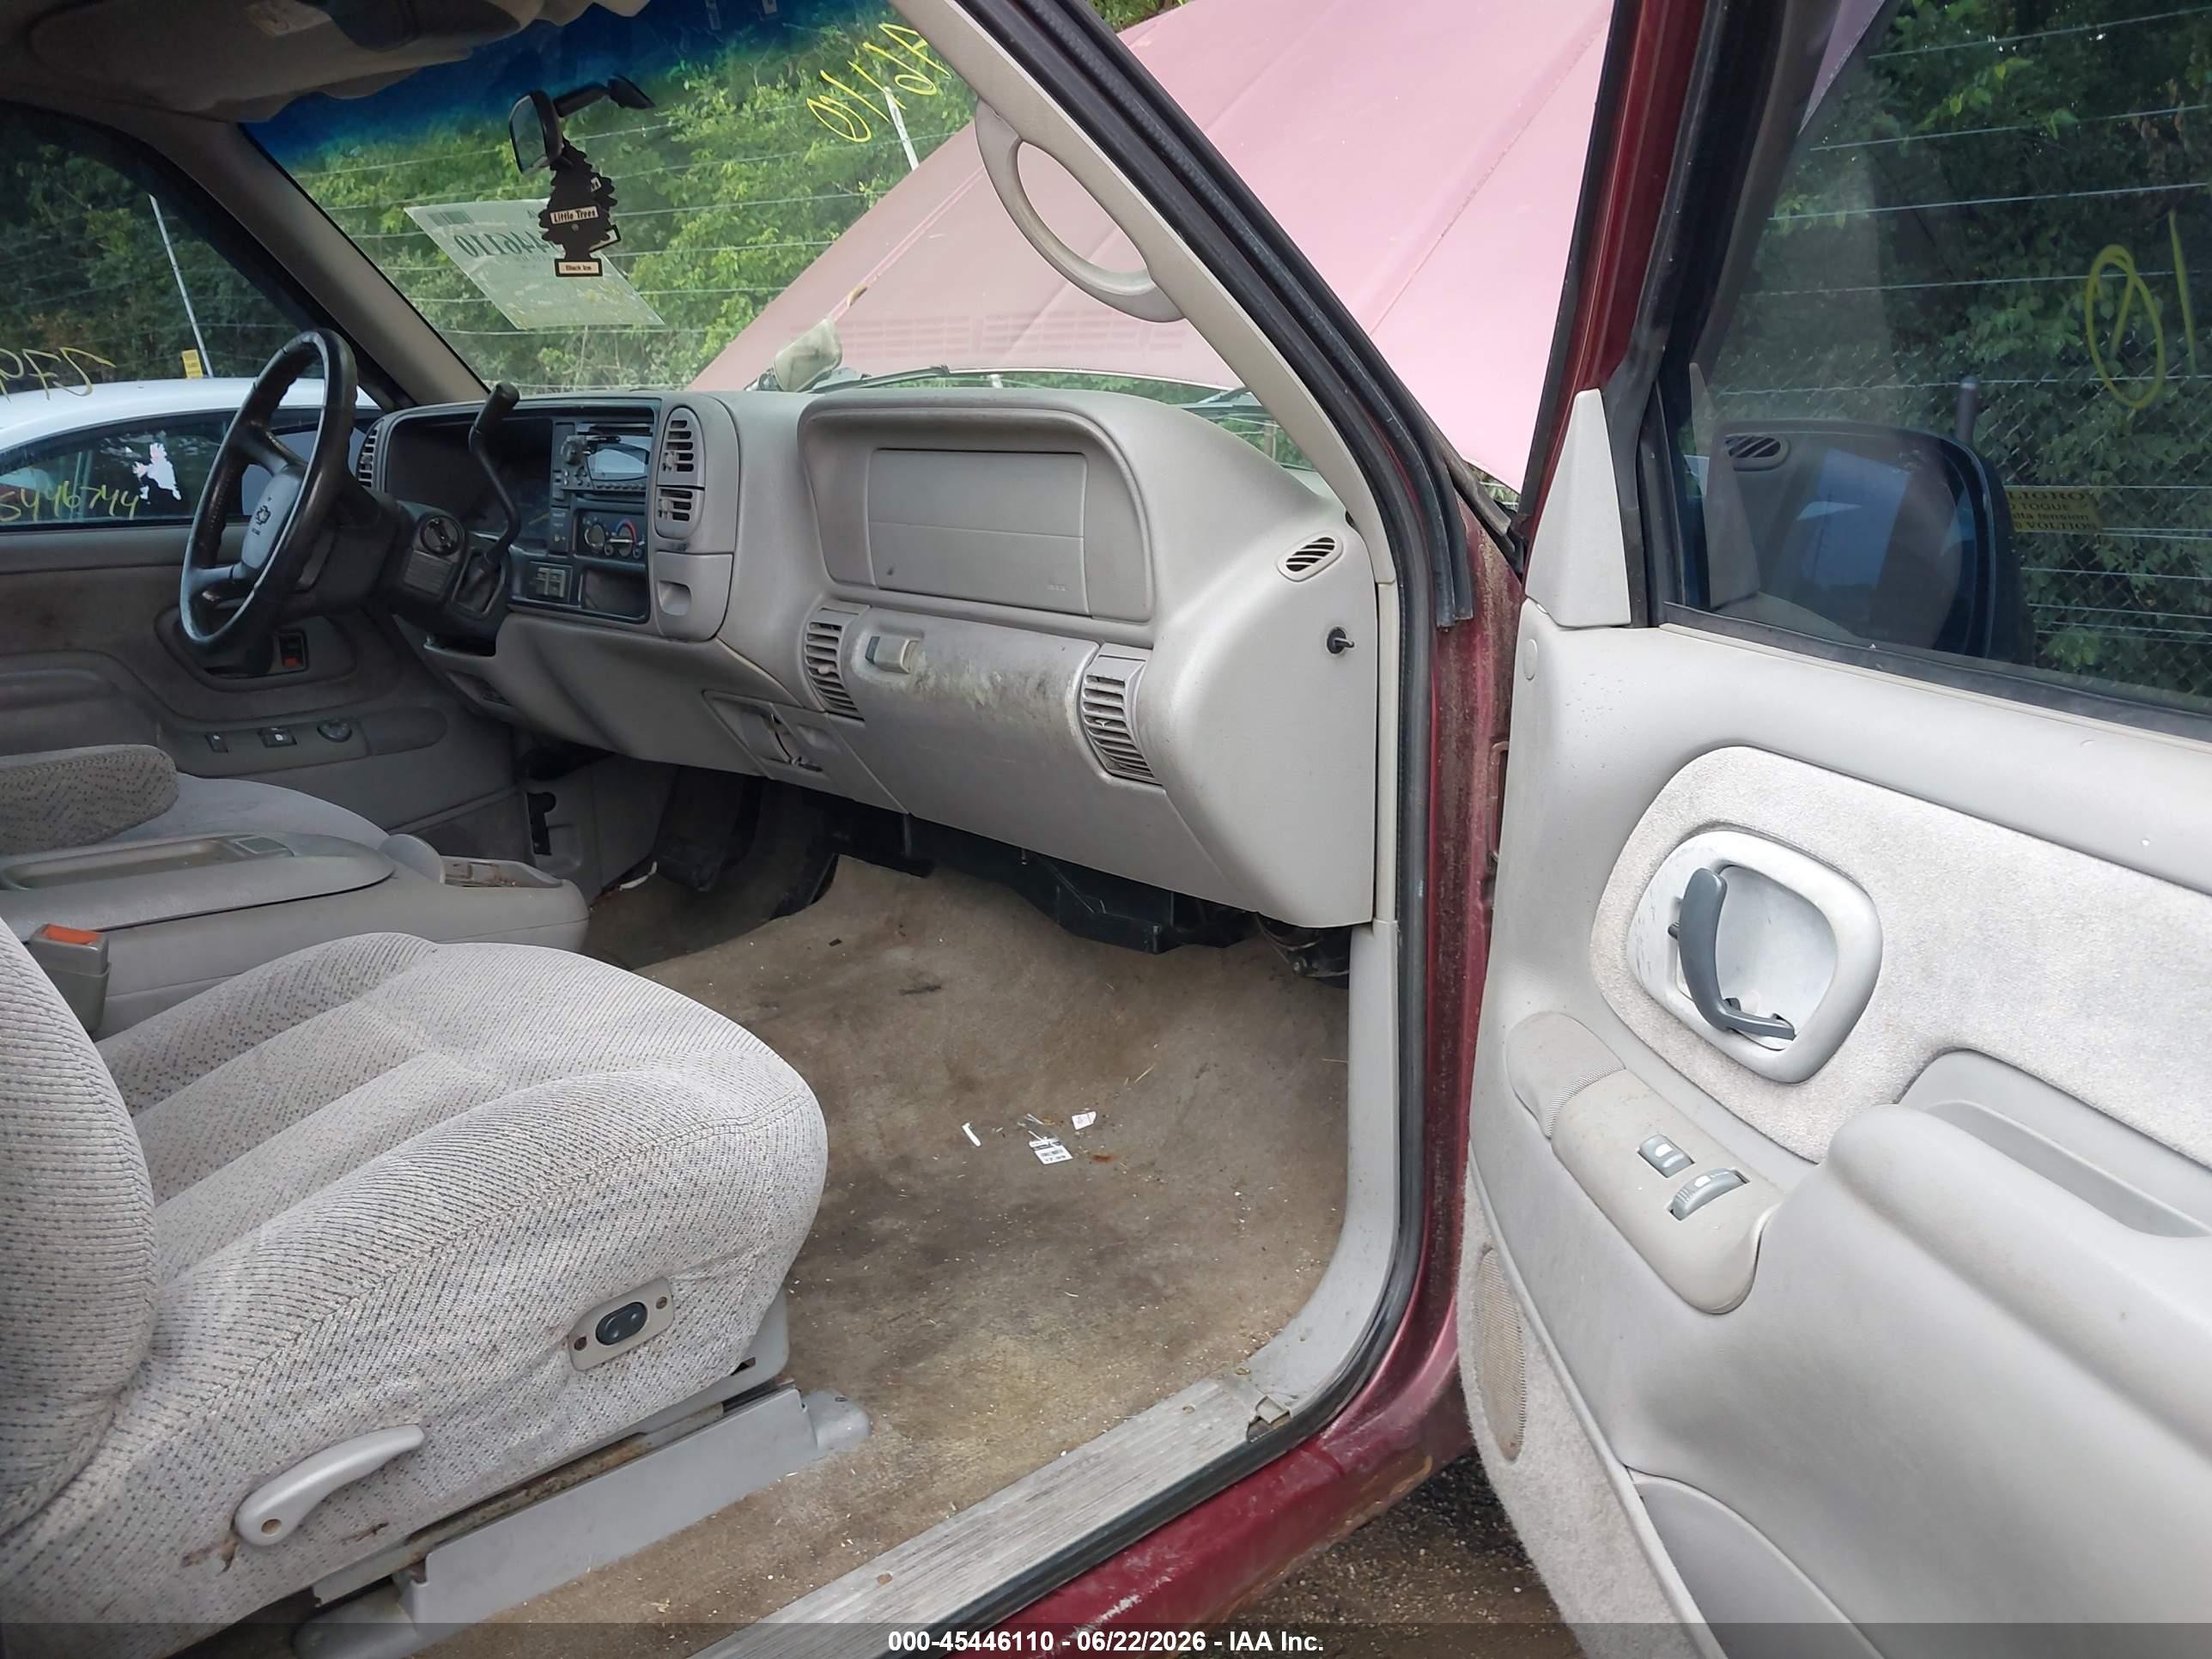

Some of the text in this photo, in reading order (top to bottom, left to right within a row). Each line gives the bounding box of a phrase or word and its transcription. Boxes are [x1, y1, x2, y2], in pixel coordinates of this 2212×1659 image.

[553, 211, 574, 223] Little
[574, 209, 596, 220] Trees
[2006, 491, 2086, 501] LIGRO
